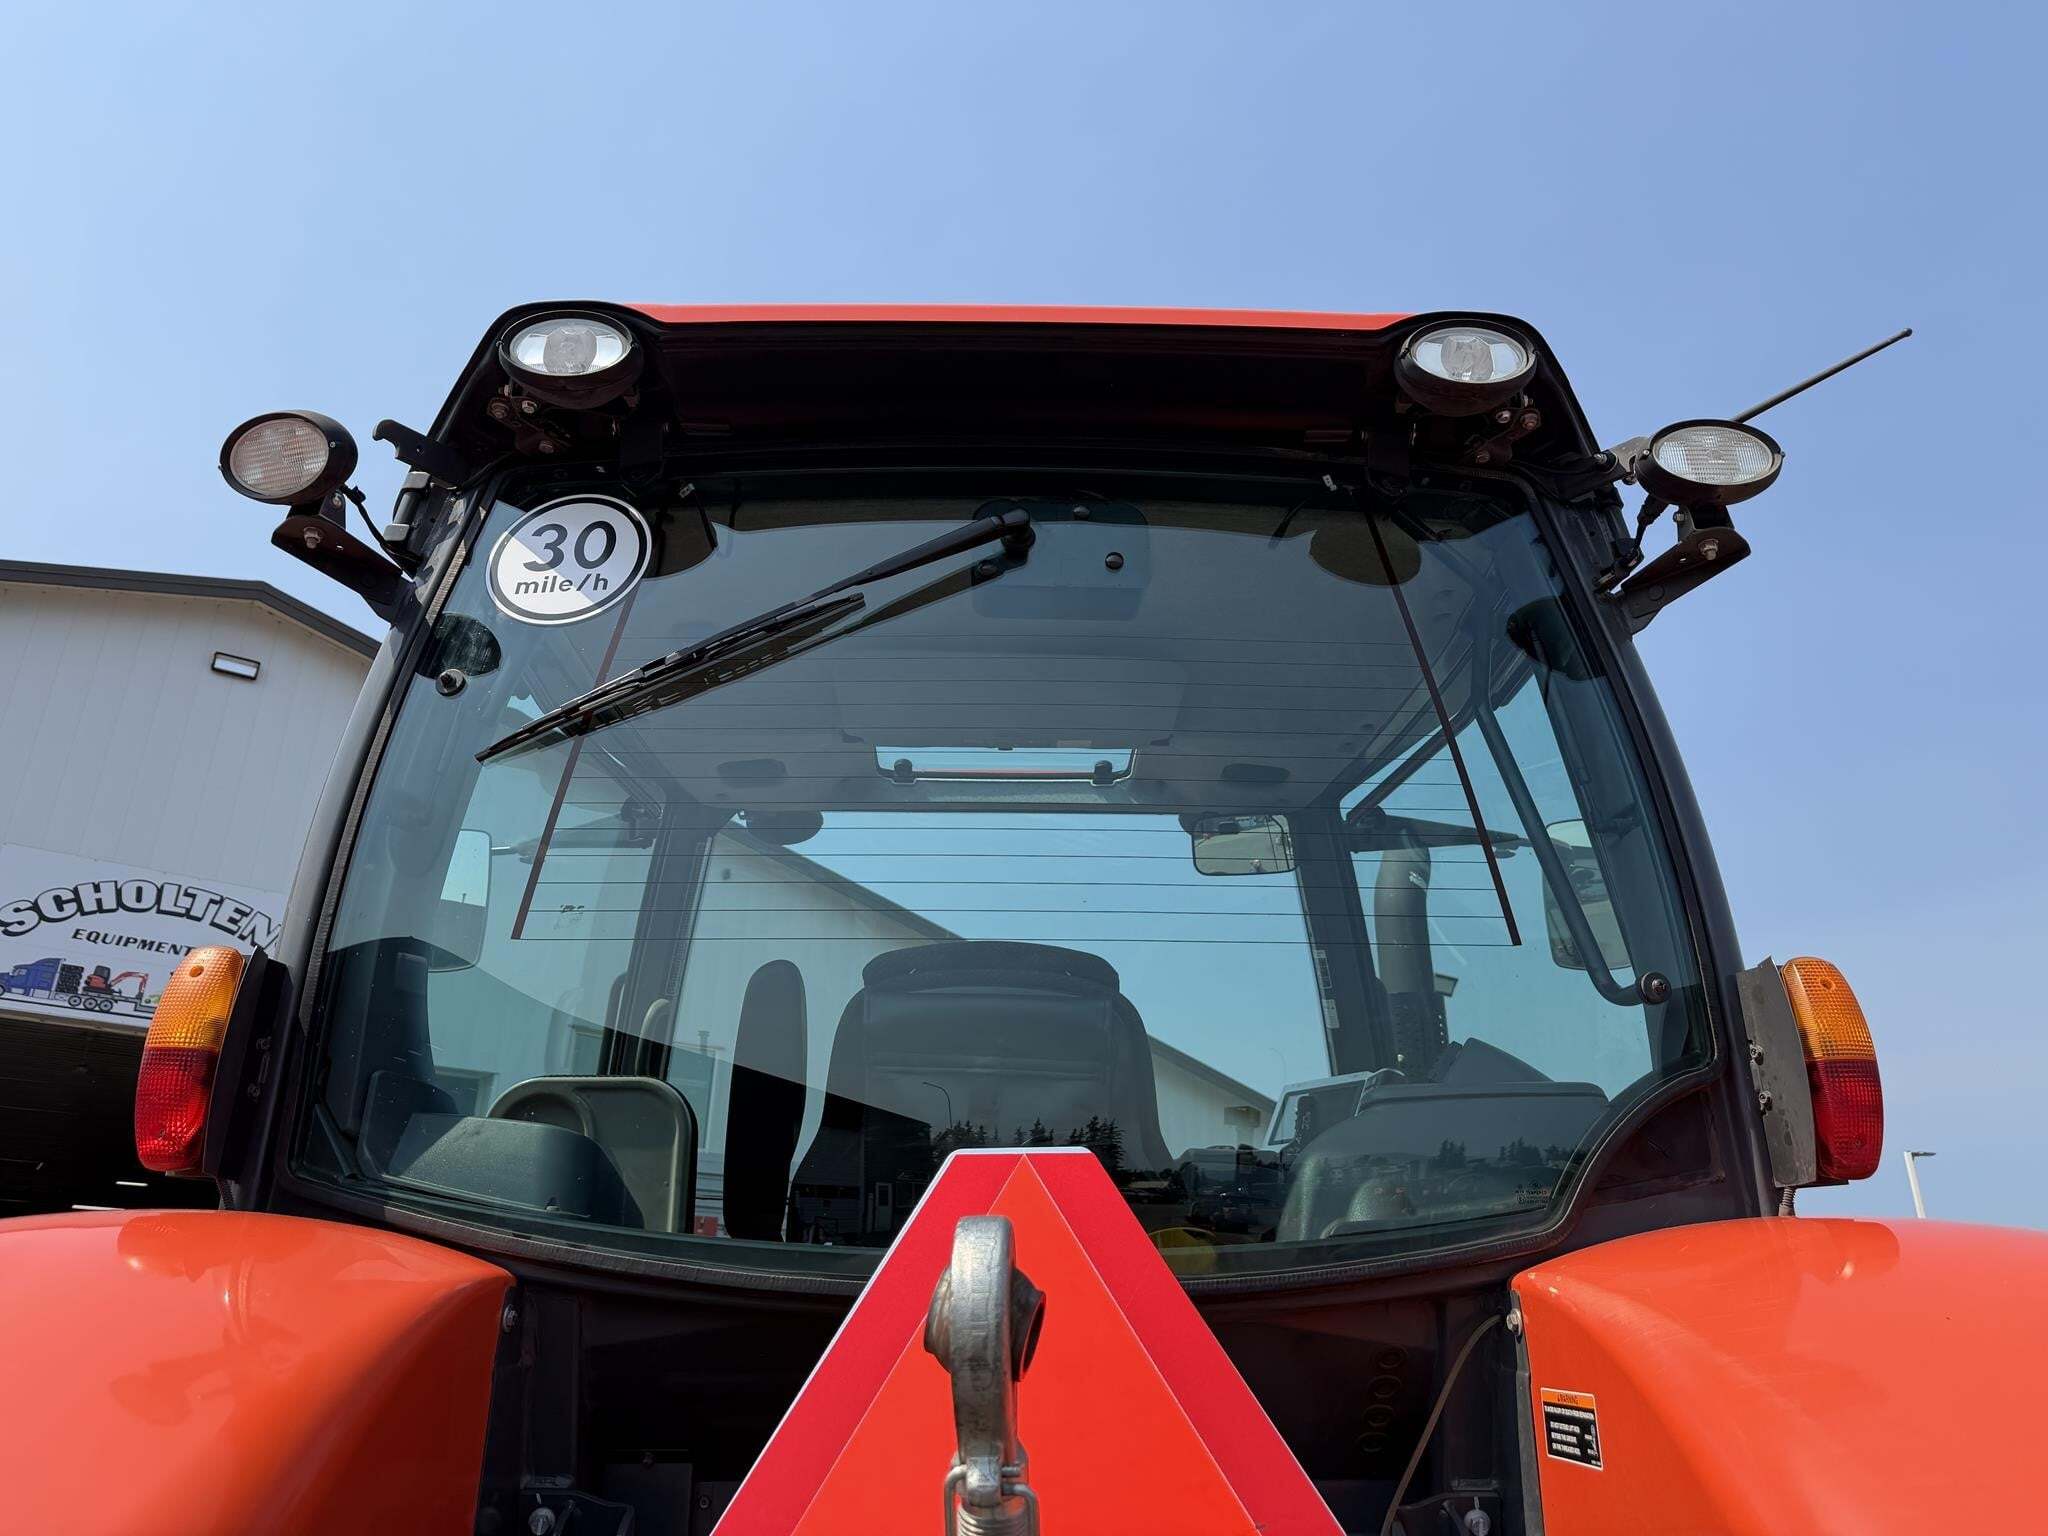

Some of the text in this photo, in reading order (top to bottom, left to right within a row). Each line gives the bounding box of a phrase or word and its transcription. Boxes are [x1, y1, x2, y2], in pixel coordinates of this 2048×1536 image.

[523, 520, 617, 572] 30
[514, 573, 609, 595] mile/h
[71, 928, 196, 957] EQUIPMENT
